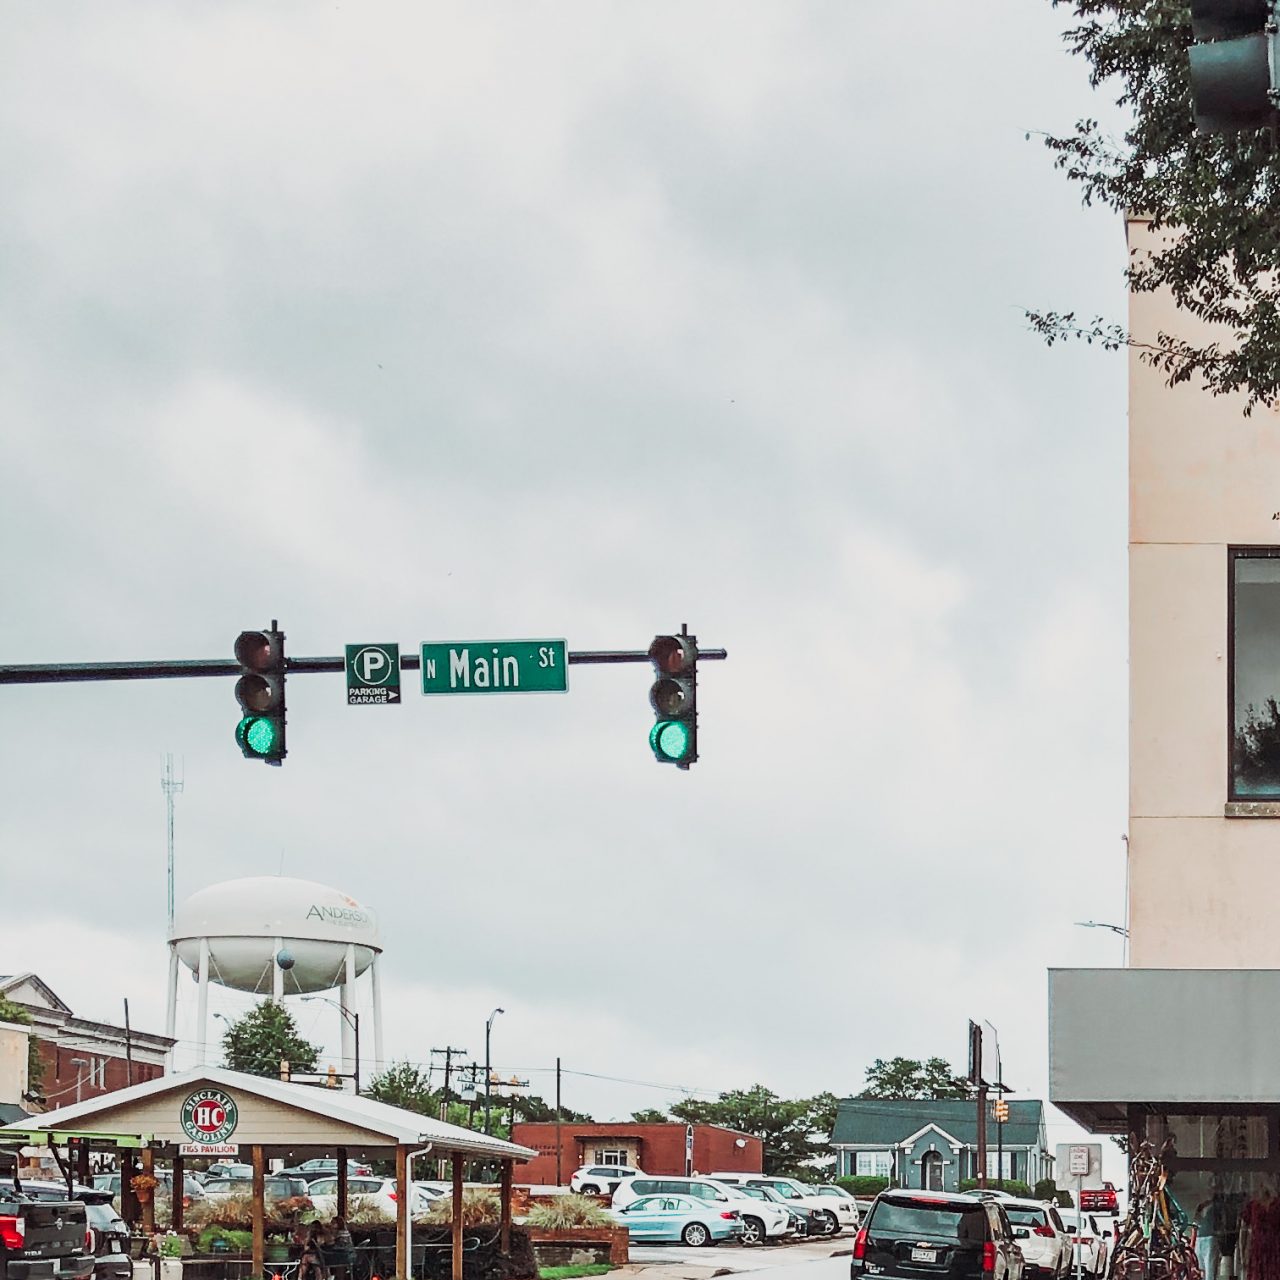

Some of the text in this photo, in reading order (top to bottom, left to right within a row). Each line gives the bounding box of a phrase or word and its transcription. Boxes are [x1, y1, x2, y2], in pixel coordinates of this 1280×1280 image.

[362, 651, 385, 680] P
[426, 646, 555, 687] N Main St
[349, 687, 387, 696] PARKING
[349, 695, 387, 704] GARAGE
[185, 1091, 233, 1113] SINCLAIR
[196, 1106, 223, 1127] HC
[185, 1121, 233, 1142] GASOLINE
[182, 1145, 236, 1153] FIGS PAVILION
